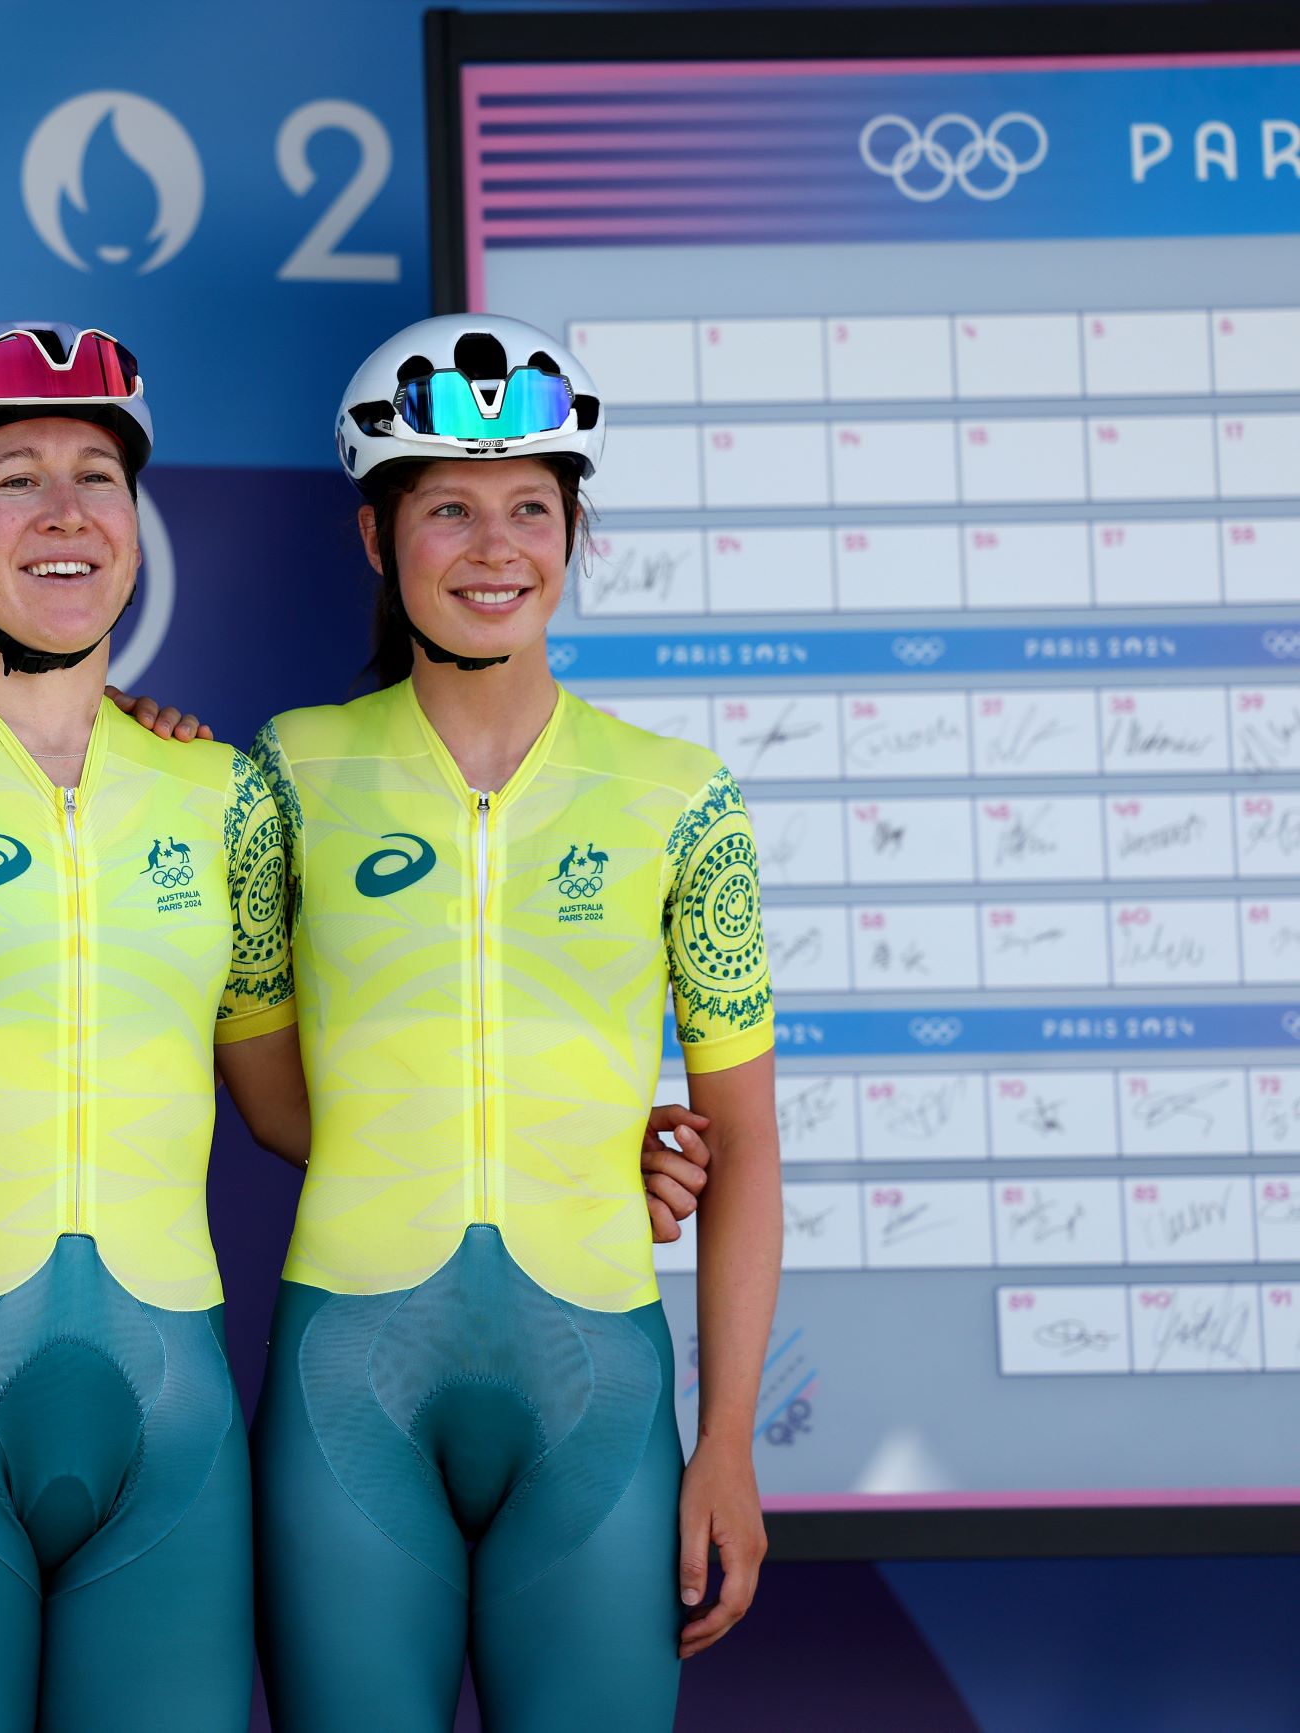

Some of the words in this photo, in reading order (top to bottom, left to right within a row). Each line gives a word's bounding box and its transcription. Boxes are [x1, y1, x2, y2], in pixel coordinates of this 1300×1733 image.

[157, 890, 201, 904] AUSTRALIA
[158, 901, 183, 914] PARIS
[184, 899, 202, 909] 2024
[558, 903, 604, 914] AUSTRALIA
[558, 913, 583, 923] PARIS
[584, 912, 604, 921] 2024
